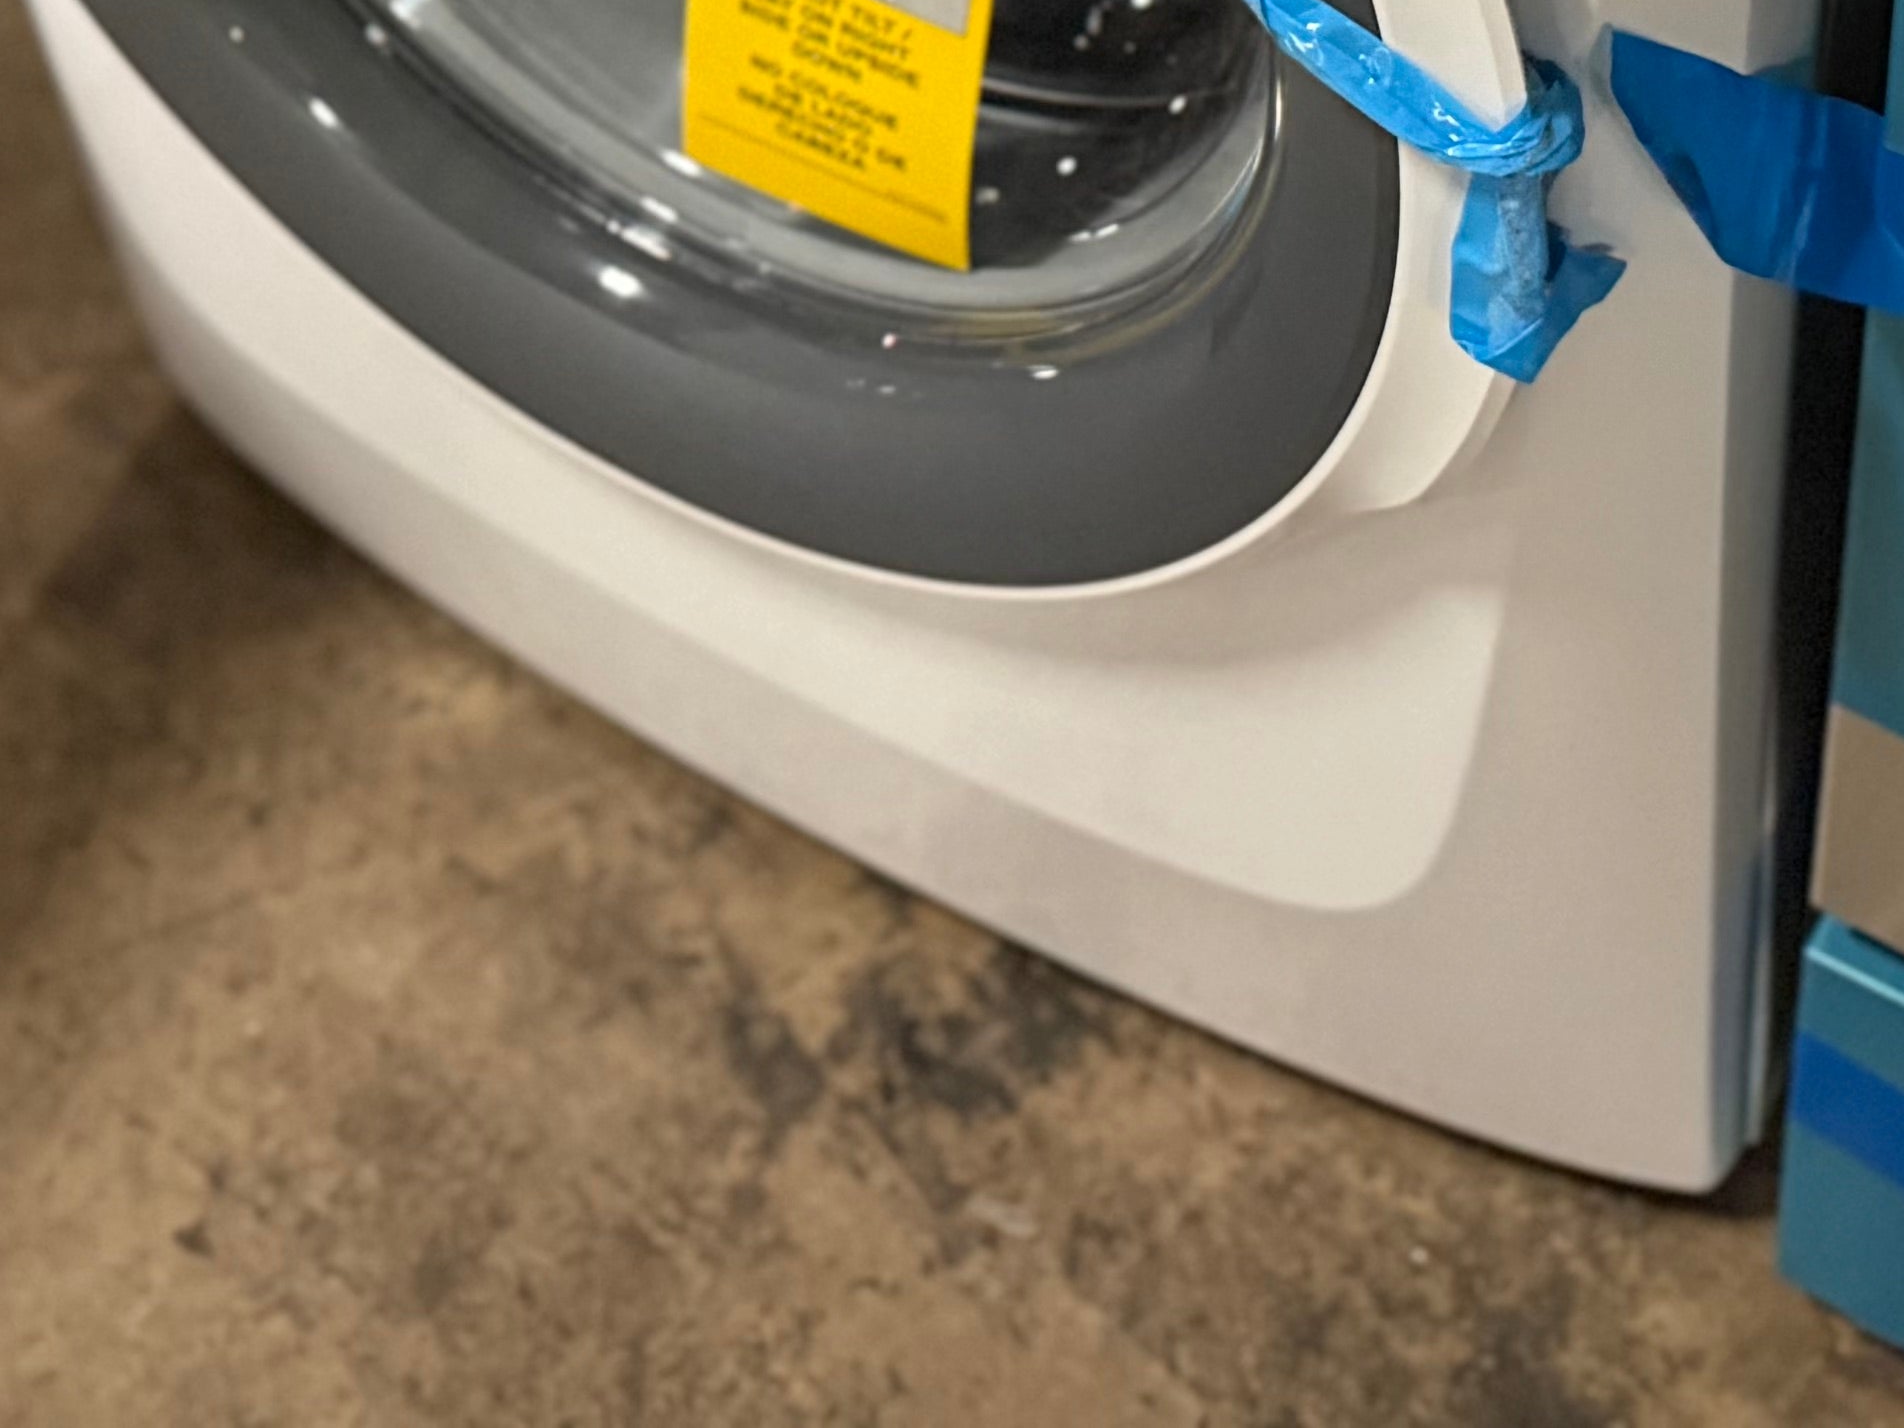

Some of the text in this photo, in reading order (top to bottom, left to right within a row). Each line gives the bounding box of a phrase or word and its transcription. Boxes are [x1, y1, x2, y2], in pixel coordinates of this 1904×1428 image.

[799, 2, 833, 27] ON
[840, 18, 913, 62] RIGHT
[851, 4, 897, 36] TILT
[740, 0, 921, 89] SIDE OR UPSIDE
[794, 43, 863, 85] DOWN
[750, 55, 784, 81] NO
